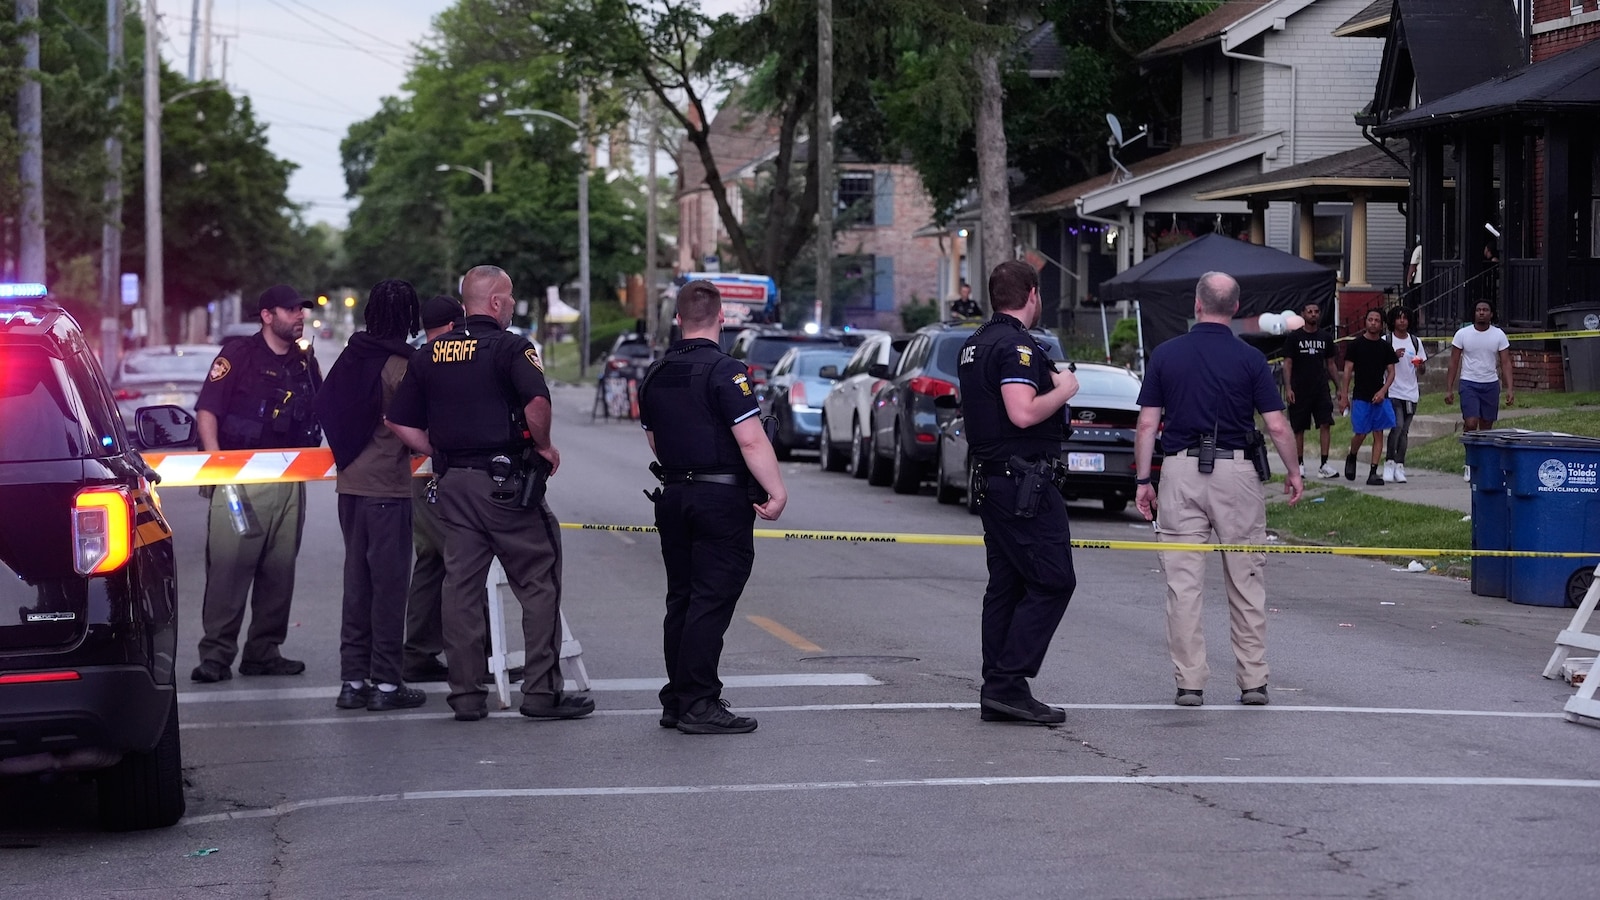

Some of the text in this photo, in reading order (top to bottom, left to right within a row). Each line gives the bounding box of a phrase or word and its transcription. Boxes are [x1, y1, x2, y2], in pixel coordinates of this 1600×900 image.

[1299, 340, 1326, 349] AMIRI
[432, 340, 478, 363] SHERIFF
[1567, 468, 1597, 477] Toledo
